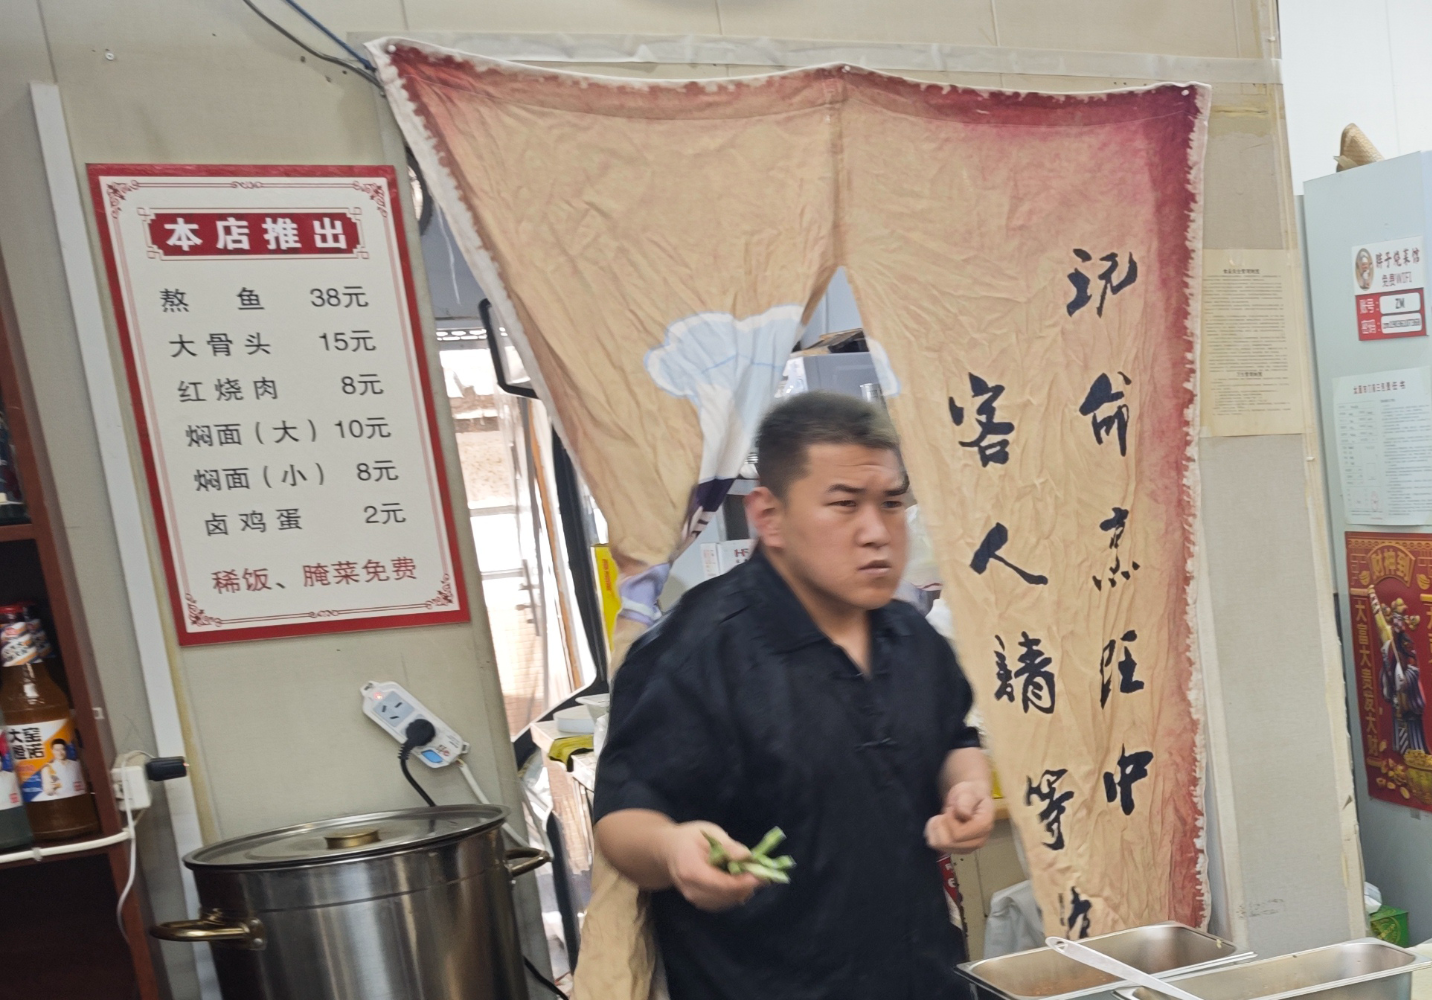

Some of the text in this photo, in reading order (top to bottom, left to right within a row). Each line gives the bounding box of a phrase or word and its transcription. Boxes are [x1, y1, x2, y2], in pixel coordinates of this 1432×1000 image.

[164, 217, 348, 251] 本店推出
[310, 286, 369, 308] 38元
[169, 330, 377, 358] 大骨头 15元
[177, 374, 384, 403] 红烧肉 8元
[334, 417, 391, 440] 10元
[356, 460, 399, 482] 8元
[204, 503, 407, 537] 卤鸡蛋 2元
[1370, 549, 1412, 582] 财神到
[1355, 600, 1379, 756] 大富大贵发大财
[9, 727, 41, 744] 大窑
[12, 743, 45, 760] 橙诺
